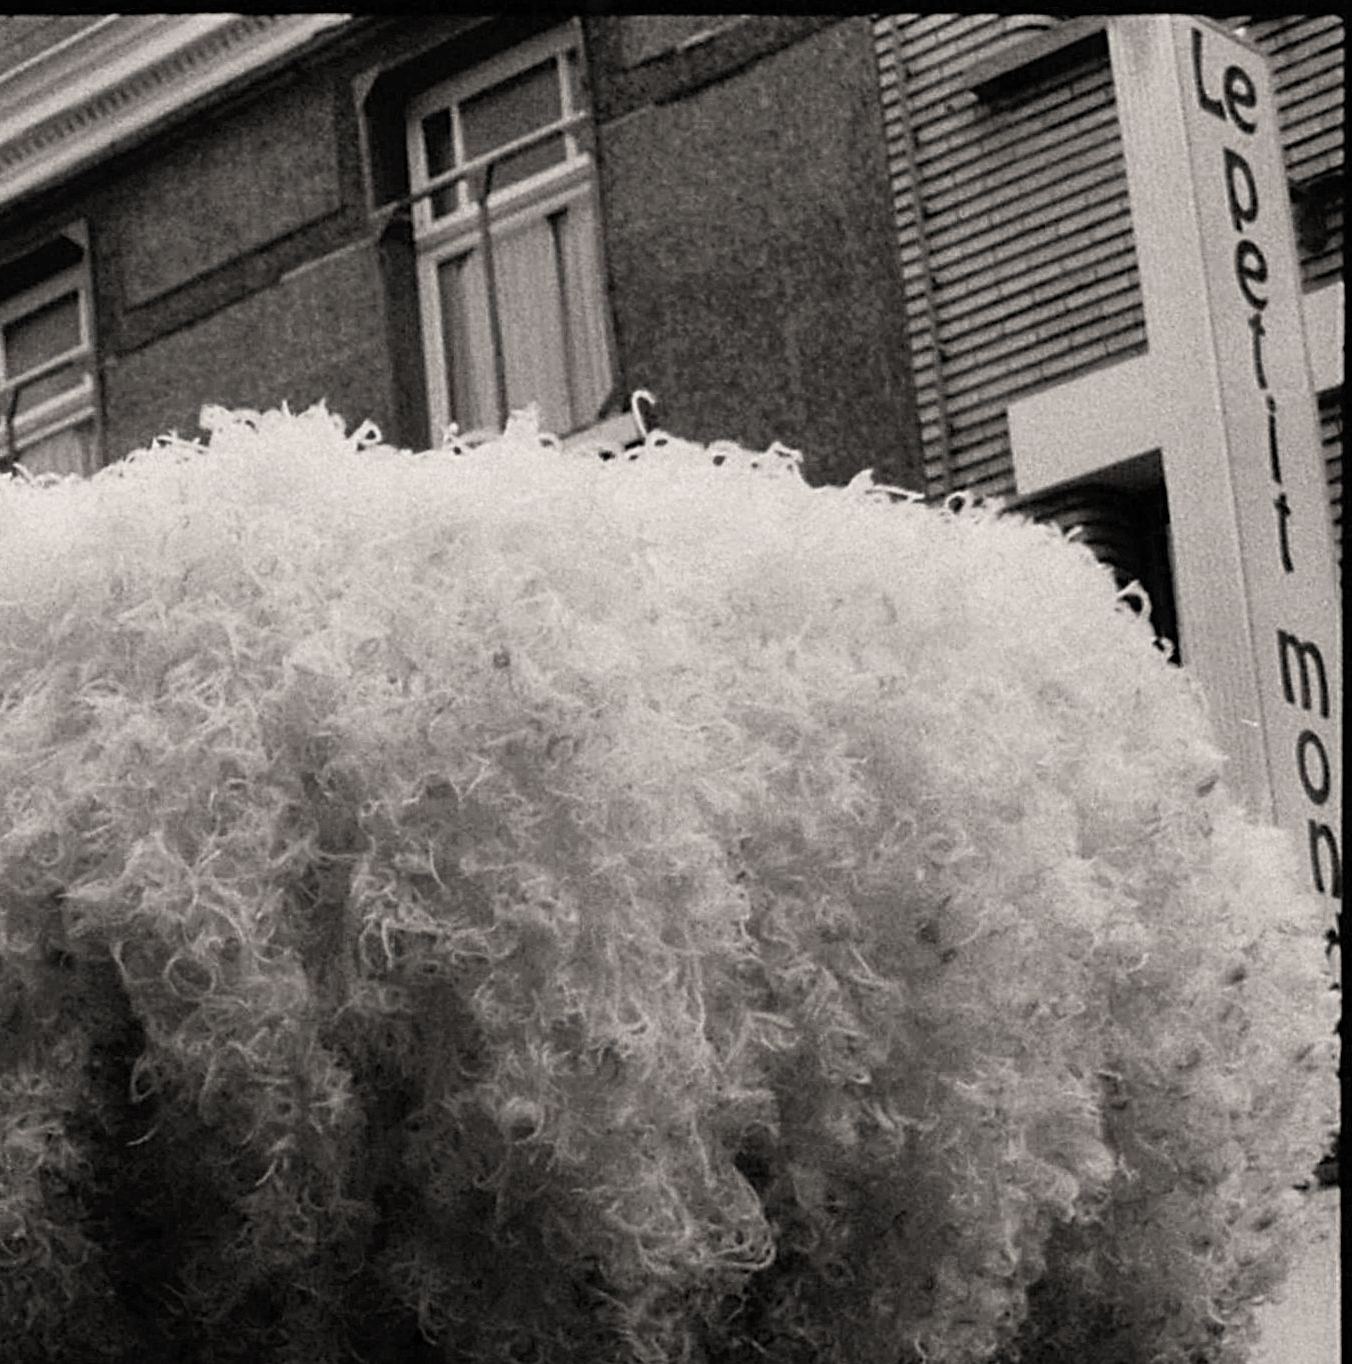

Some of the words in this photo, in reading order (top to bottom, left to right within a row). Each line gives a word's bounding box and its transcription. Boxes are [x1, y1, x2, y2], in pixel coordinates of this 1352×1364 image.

[1192, 27, 1257, 135] Le
[1223, 148, 1294, 574] petit
[1276, 628, 1341, 948] mon
